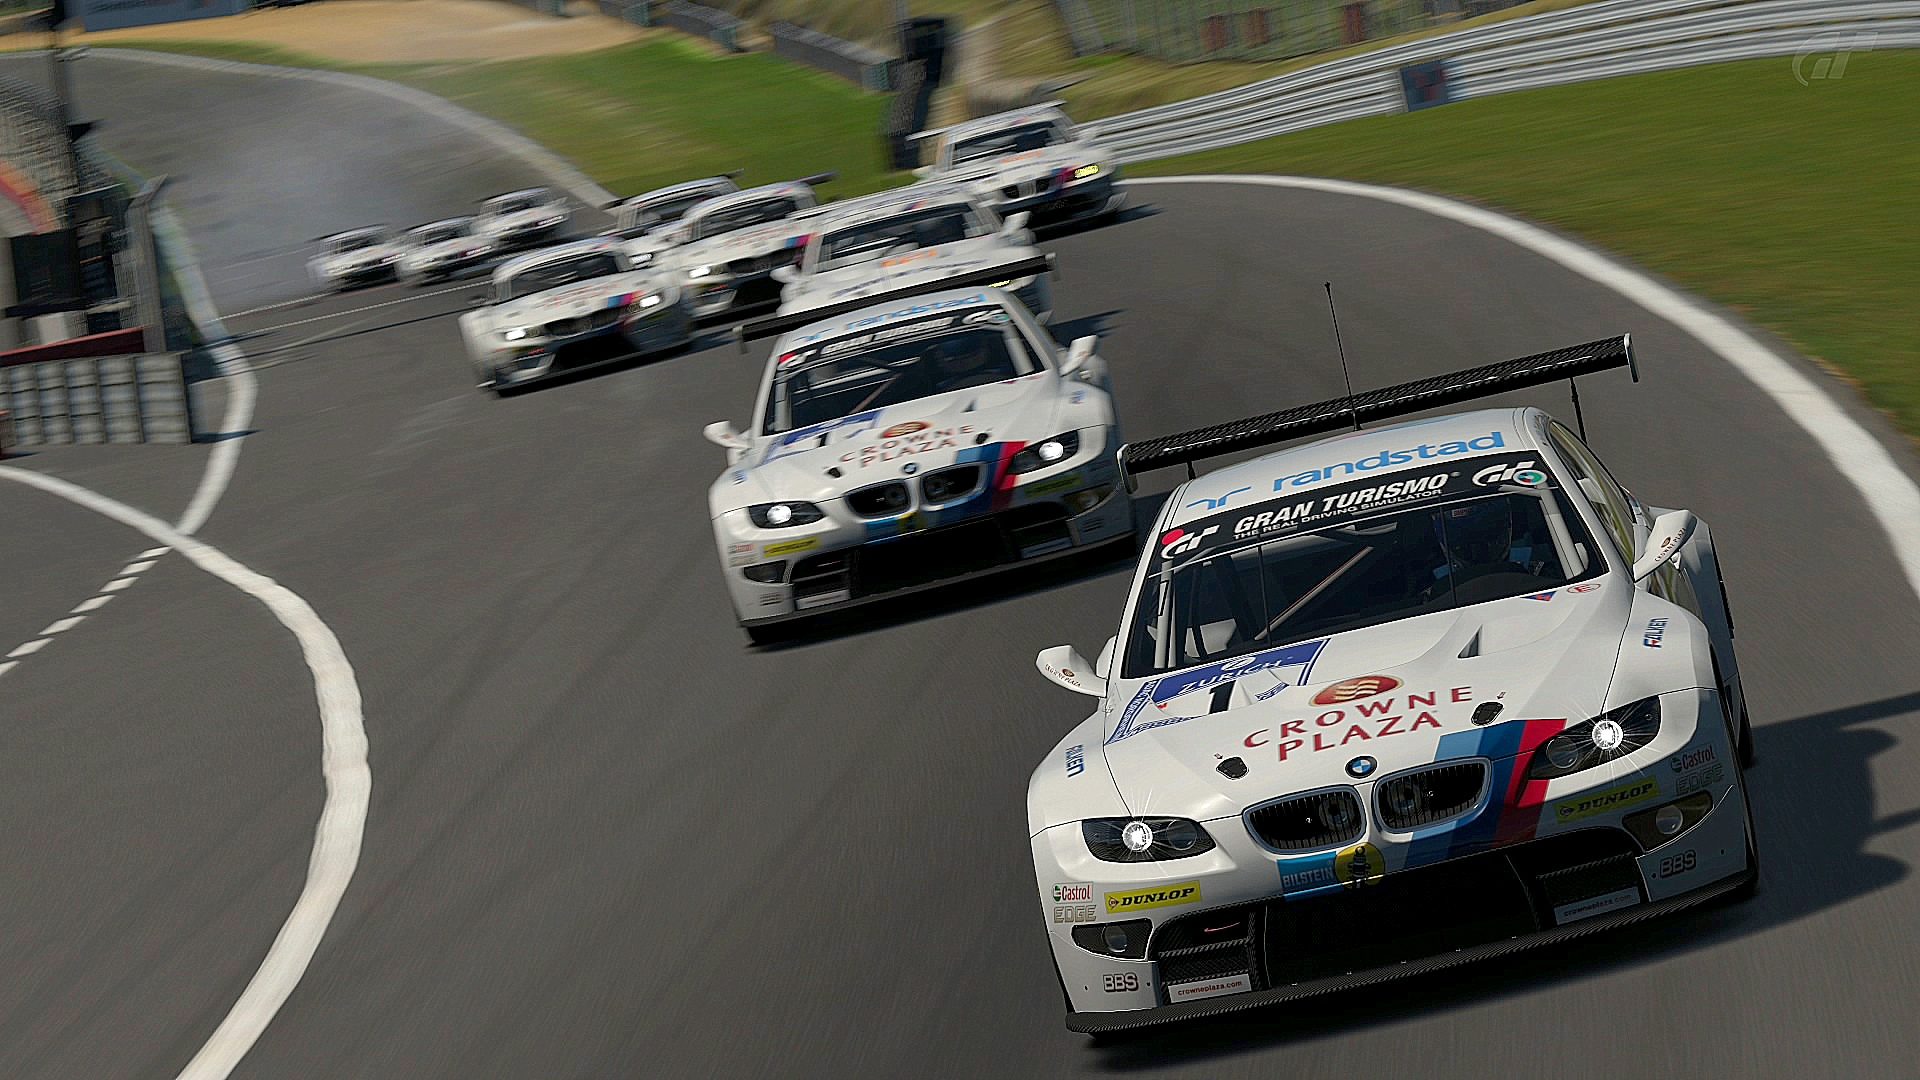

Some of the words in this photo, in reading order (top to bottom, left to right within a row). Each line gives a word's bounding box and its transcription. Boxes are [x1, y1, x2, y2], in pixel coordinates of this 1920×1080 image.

[1272, 431, 1505, 492] randstad
[1233, 499, 1314, 534] GRAN
[1322, 472, 1449, 513] TURISMO
[1234, 529, 1259, 541] THE
[1262, 520, 1299, 534] REAL
[1301, 505, 1359, 523] DRIVING
[1360, 488, 1443, 511] SIMULATOR
[1208, 680, 1237, 715] 1
[1243, 685, 1474, 749] CROWNE
[1278, 711, 1443, 762] PLAZA
[1680, 745, 1715, 770] Castrol
[1676, 764, 1724, 794] EDGE
[1577, 783, 1654, 811] DUNLOP
[1283, 865, 1334, 889] BILSTEIN
[1659, 850, 1698, 879] BBS
[1061, 884, 1091, 901] Castrol
[1120, 887, 1195, 907] DUNLOP
[1053, 904, 1097, 924] EDGE
[1103, 972, 1140, 993] BBS
[1177, 979, 1243, 997] crowneplaza.com
